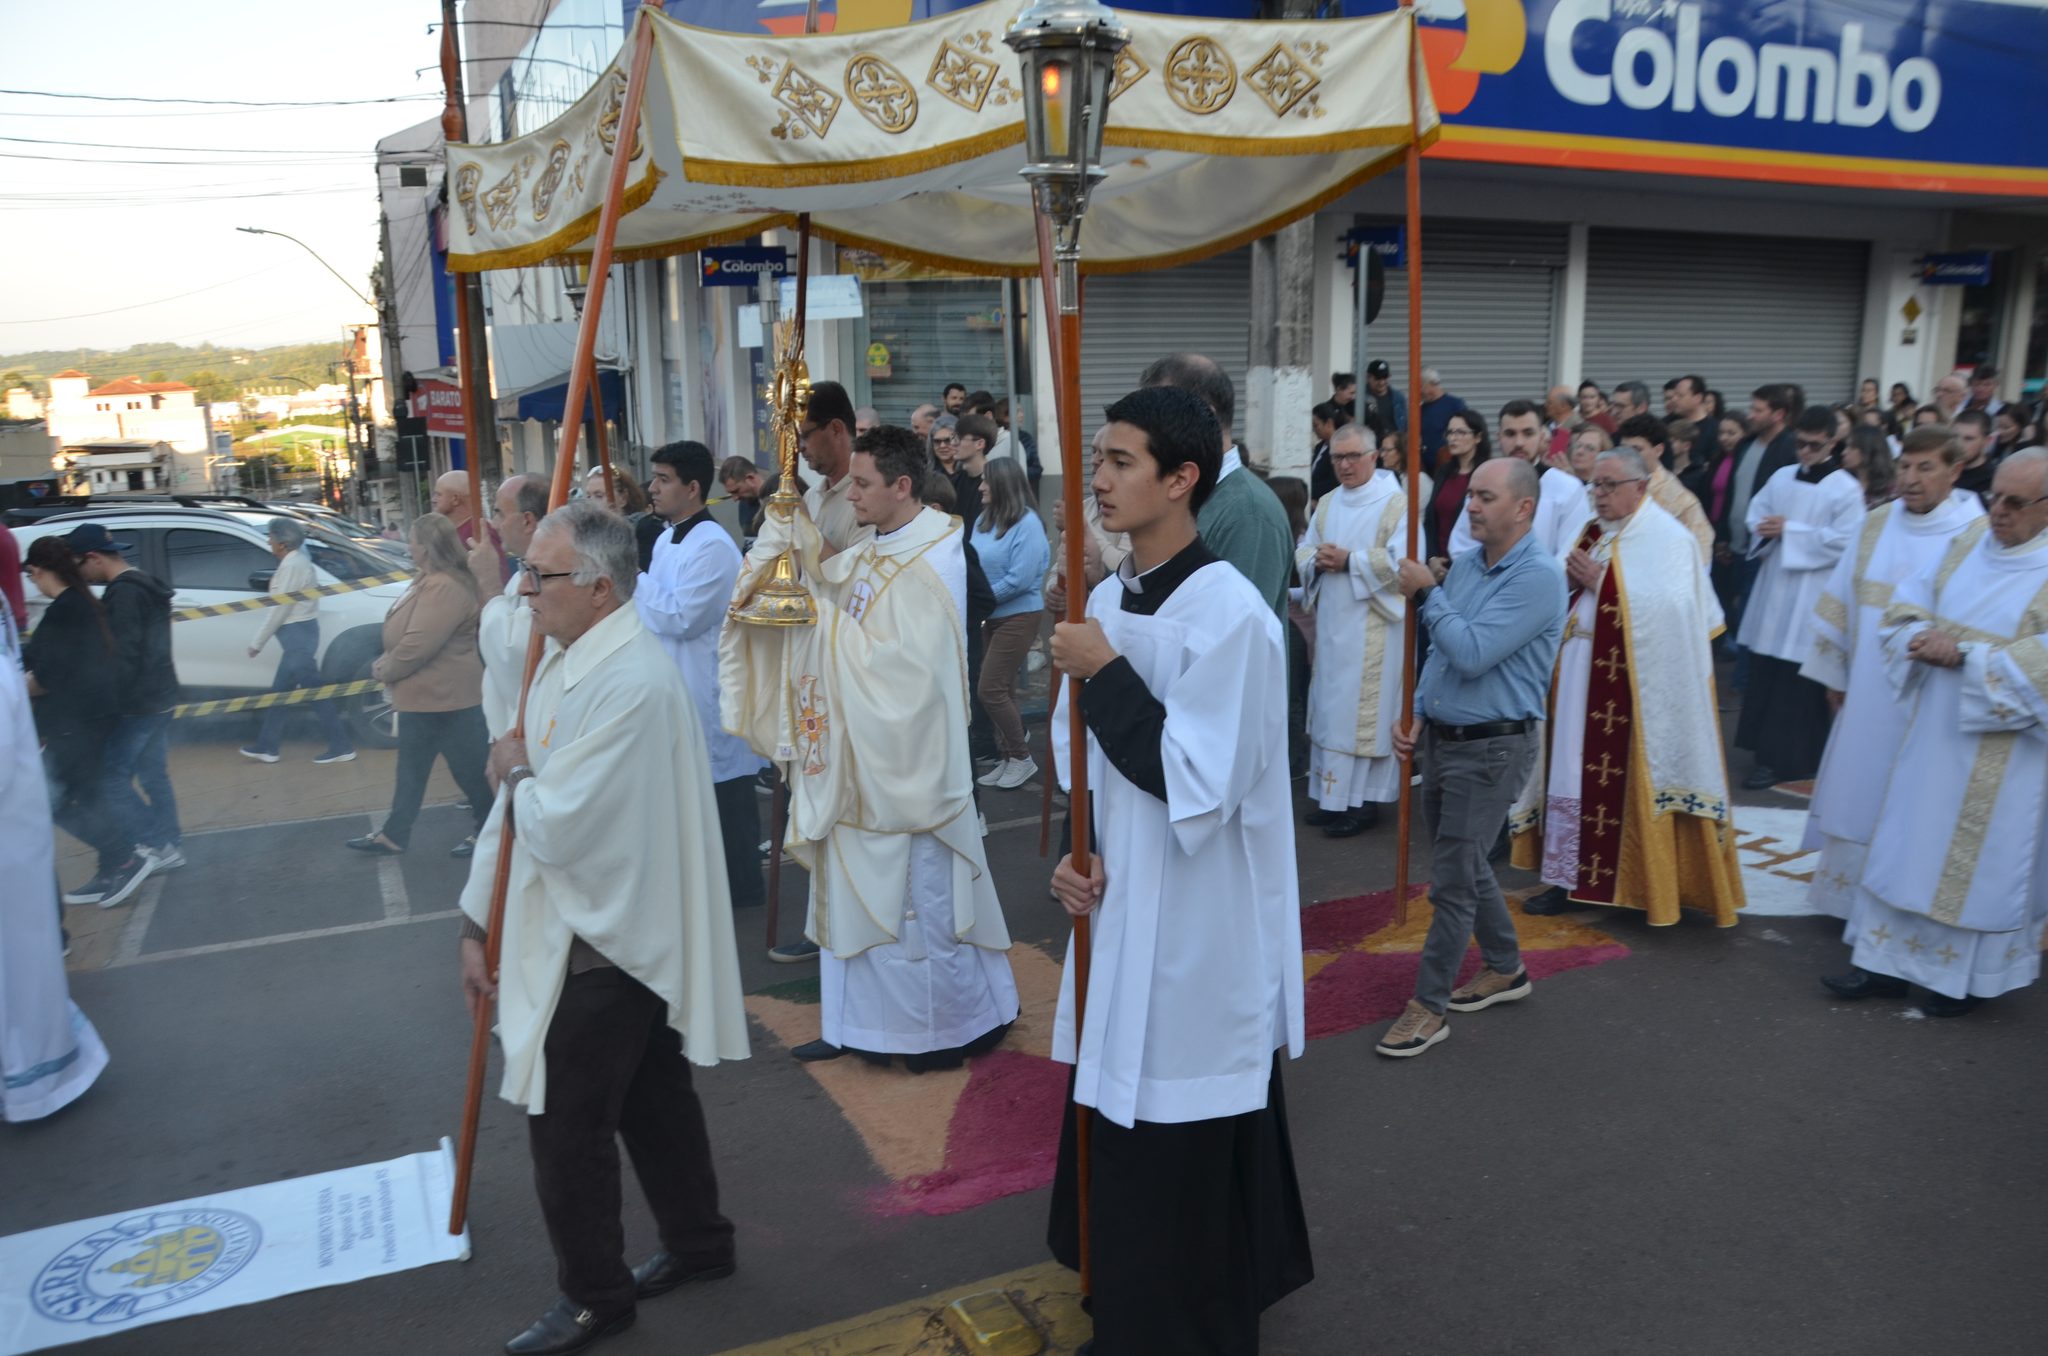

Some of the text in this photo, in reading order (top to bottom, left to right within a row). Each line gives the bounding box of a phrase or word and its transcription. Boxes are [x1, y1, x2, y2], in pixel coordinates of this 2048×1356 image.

[1544, 0, 1942, 132] Colombo
[721, 259, 784, 273] Colombo
[430, 390, 462, 407] BARATO
[41, 1236, 119, 1317] SERRA
